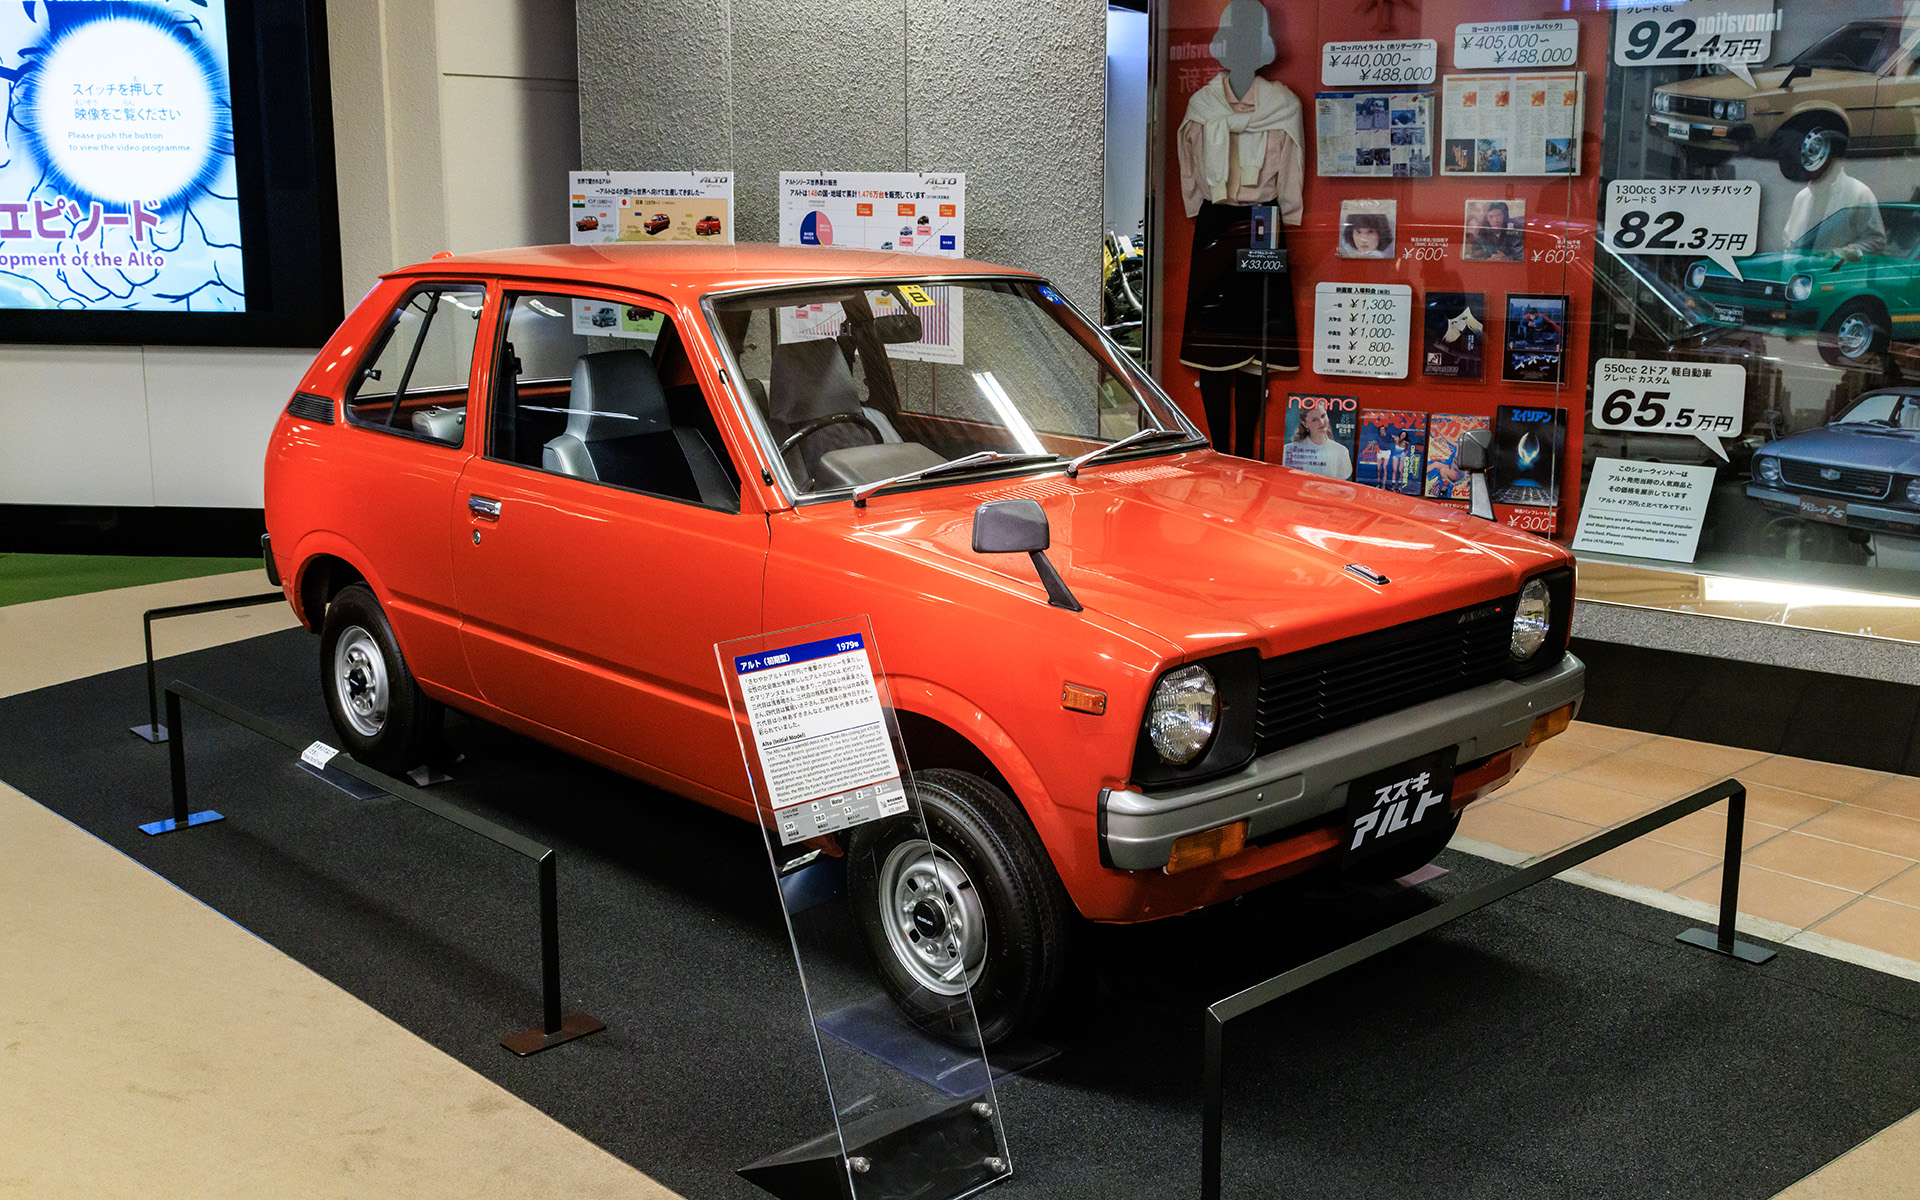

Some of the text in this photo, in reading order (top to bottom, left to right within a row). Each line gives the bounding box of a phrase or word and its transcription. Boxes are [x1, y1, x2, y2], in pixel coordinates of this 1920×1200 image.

[1663, 5, 1674, 13] GL
[1471, 24, 1519, 33] ヨーロッパ9日間
[1624, 18, 1762, 60] 92.4万円
[1330, 43, 1385, 51] ヨーロッパハイライト
[1494, 48, 1572, 64] ¥488,000
[1359, 67, 1432, 83] ¥488,000
[73, 83, 164, 96] スイッチを押して
[74, 107, 181, 121] 映像をご覧ください
[97, 132, 117, 140] push
[700, 176, 728, 184] ALTO
[1616, 185, 1752, 196] 1300cc 3ドア ハッチバック
[1615, 196, 1657, 204] グレード S
[1613, 210, 1748, 251] 82.3万円
[72, 251, 89, 266] of
[94, 251, 122, 266] the
[128, 252, 164, 266] Alto
[1604, 364, 1712, 378] 550cc 2ドア 軽自動車
[1604, 374, 1670, 384] グレード カスタム
[1512, 409, 1551, 423] エイリアン
[1601, 389, 1734, 432] 65.5万円
[1363, 411, 1426, 429] POPEYE
[1618, 465, 1688, 477] このショーウィンドーは
[1607, 474, 1693, 489] アルト発売当時の人気商品と
[1607, 485, 1688, 499] その価格を展示しています
[1373, 771, 1430, 808] スズキ
[1350, 790, 1444, 851] アルト
